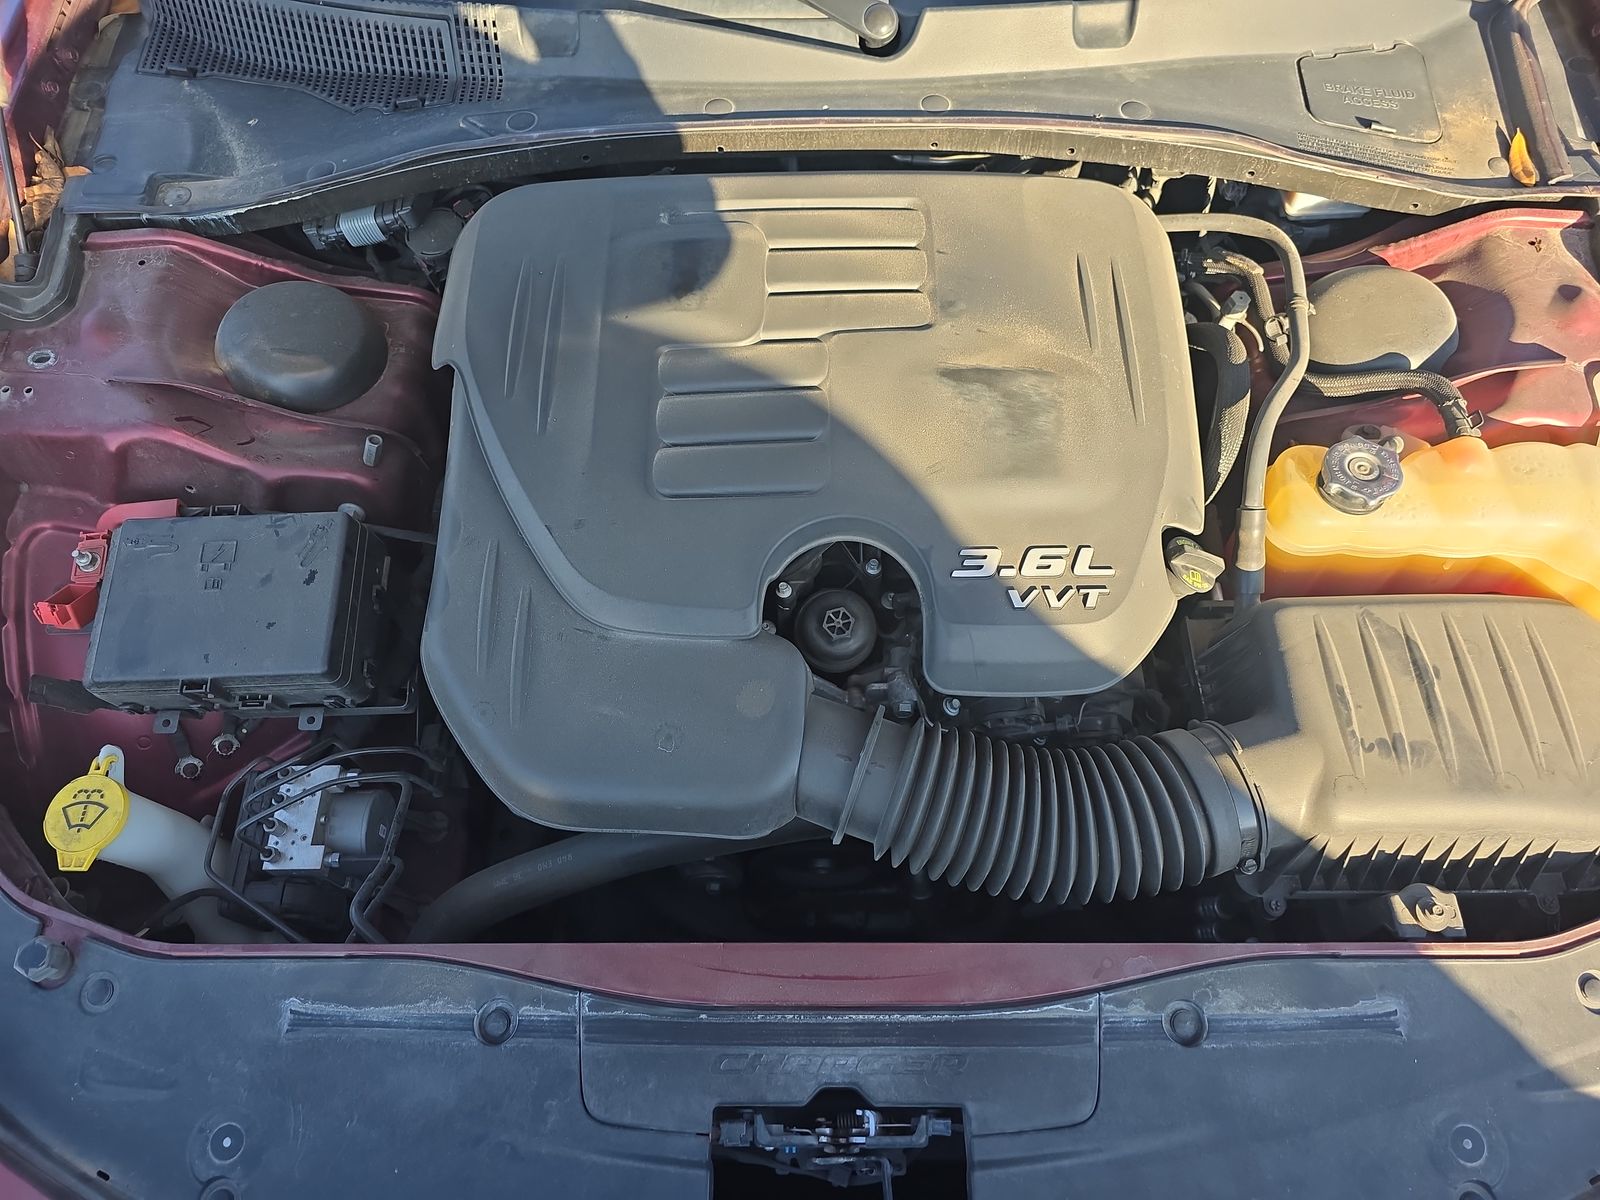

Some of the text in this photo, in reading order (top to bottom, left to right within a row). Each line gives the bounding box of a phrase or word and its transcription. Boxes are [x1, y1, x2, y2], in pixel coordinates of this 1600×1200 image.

[1324, 83, 1416, 100] BRAKE FLUID
[1344, 96, 1399, 109] ACCESS
[951, 545, 1116, 578] 3.6L
[1007, 585, 1110, 609] VVT
